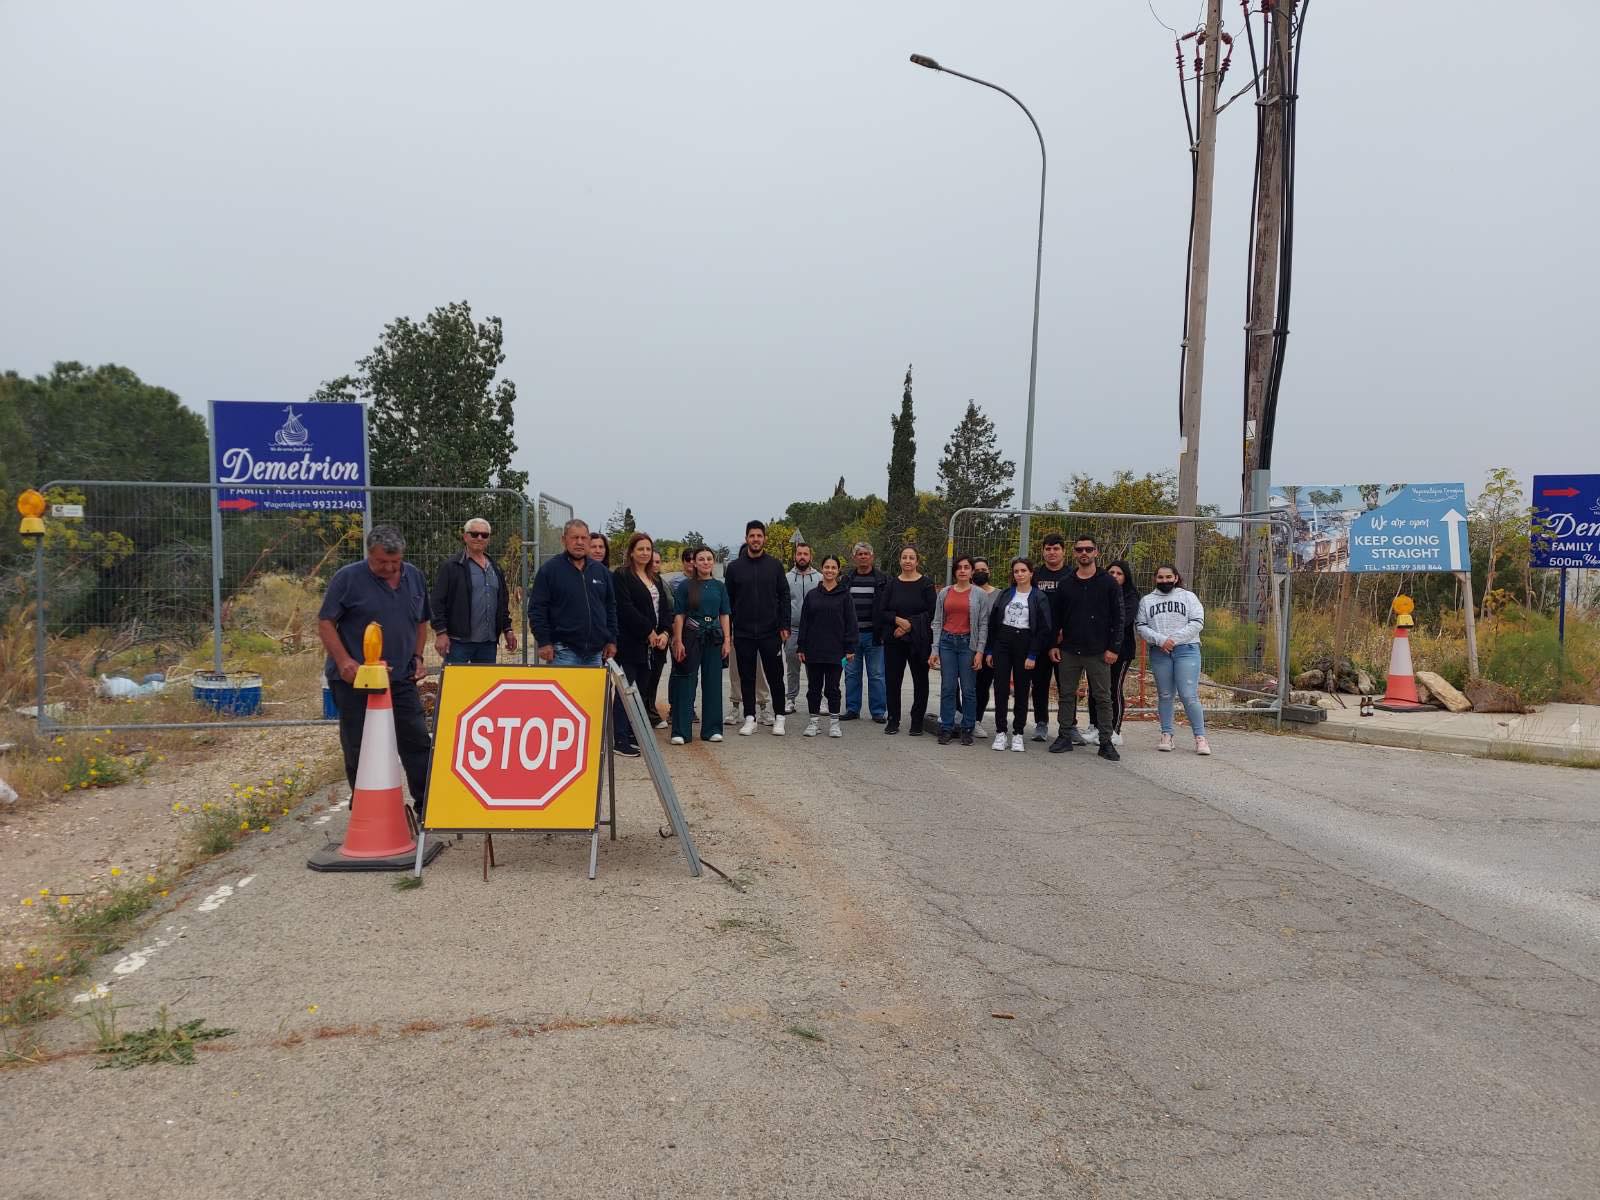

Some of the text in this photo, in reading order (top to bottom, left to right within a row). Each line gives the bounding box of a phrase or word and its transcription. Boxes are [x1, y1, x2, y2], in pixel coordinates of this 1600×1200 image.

[220, 447, 359, 483] Demetrion
[312, 500, 363, 509] 99323403
[1371, 515, 1388, 530] We
[1354, 535, 1440, 545] KEEP GOING
[1551, 542, 1593, 551] FAMILY
[1371, 548, 1440, 559] STRAIGHT
[1549, 557, 1583, 566] 500m
[1149, 601, 1186, 618] OXFORD
[467, 716, 575, 771] STOP
